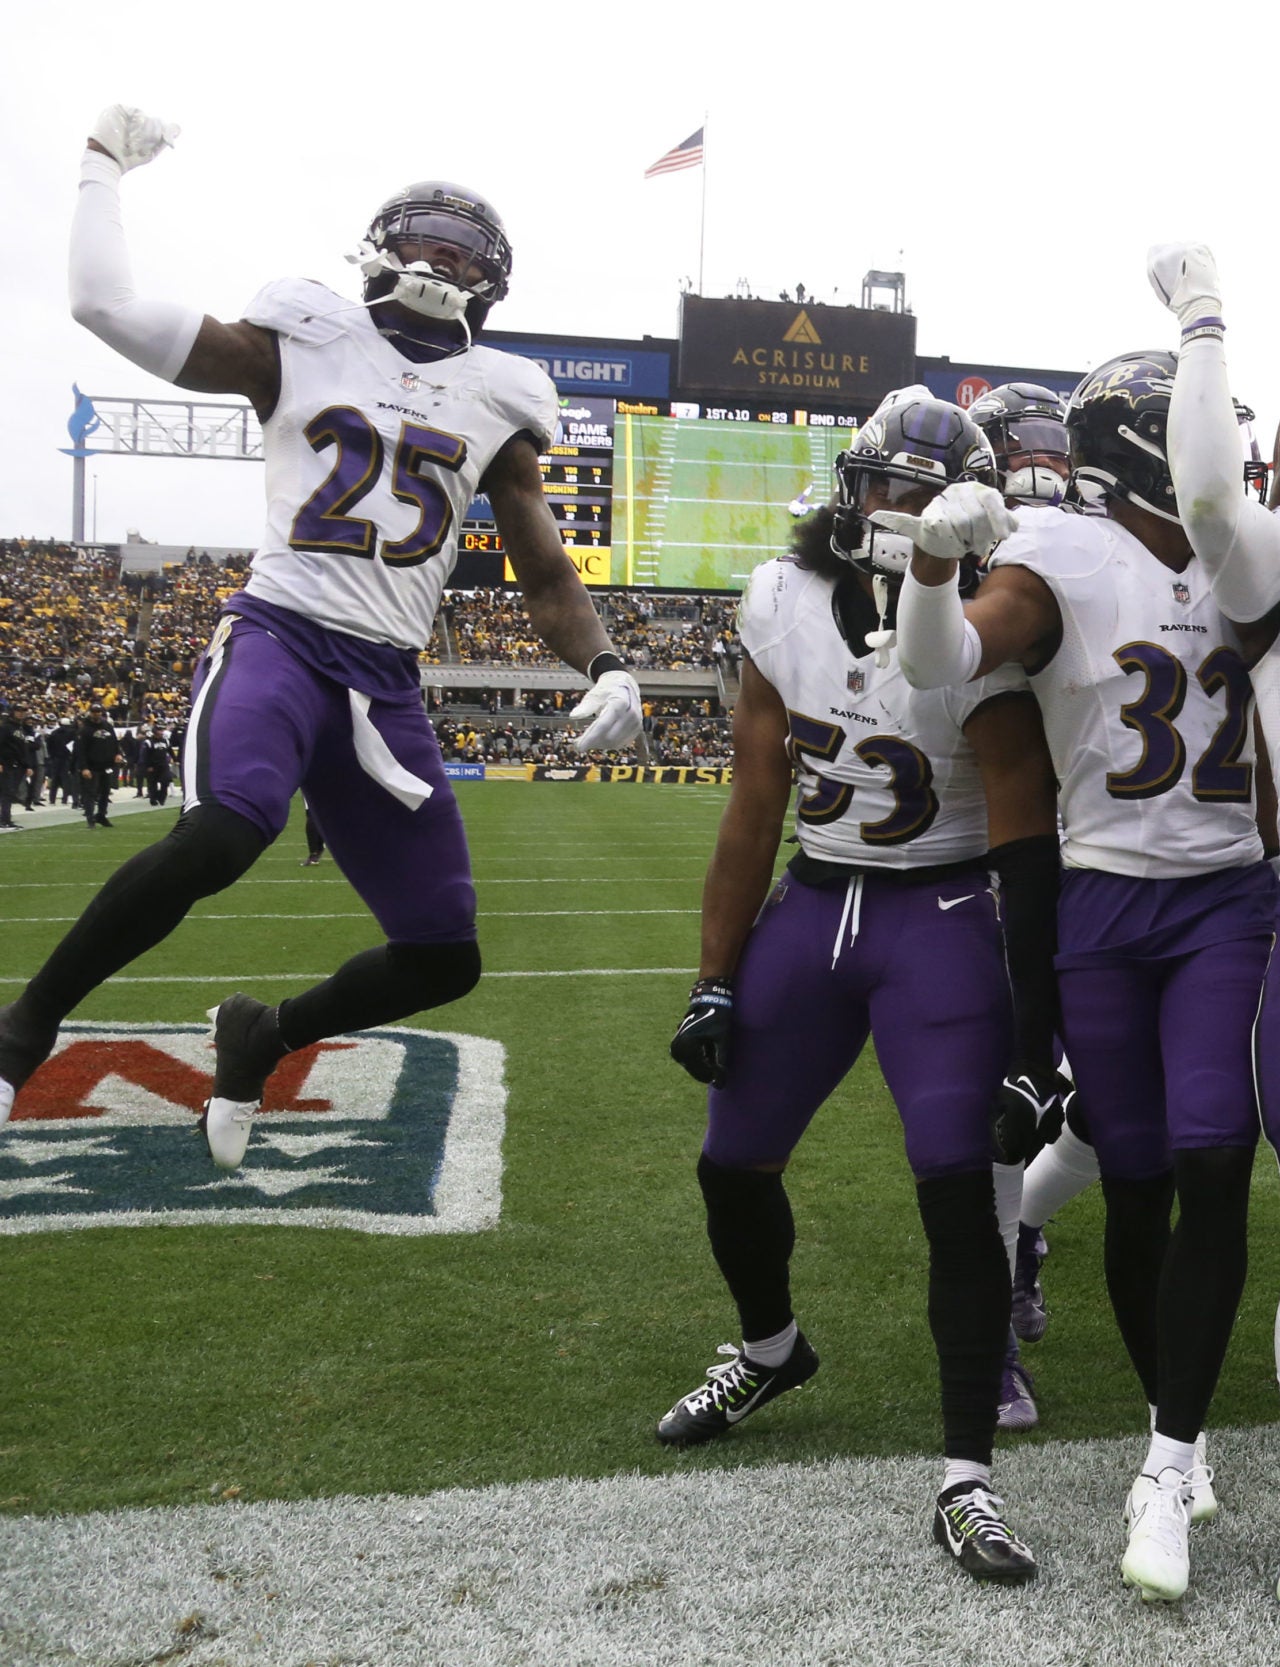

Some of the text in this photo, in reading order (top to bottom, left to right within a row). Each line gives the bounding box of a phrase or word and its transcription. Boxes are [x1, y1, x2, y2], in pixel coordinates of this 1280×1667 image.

[732, 348, 870, 373] ACRISURE
[553, 360, 627, 382] LIGHT
[759, 371, 840, 389] STADIUM
[376, 402, 428, 420] RAVENS
[617, 401, 658, 415] Steelers
[809, 414, 835, 426] 2ND
[838, 416, 858, 426] 0:21
[569, 422, 609, 436] GAME
[563, 434, 613, 446] LEADERS
[547, 446, 579, 456] ASSING
[289, 405, 467, 567] 25
[465, 534, 501, 550] 0:21
[572, 556, 602, 575] NC
[1159, 624, 1208, 633] RAVENS
[829, 706, 878, 726] RAVENS
[1107, 640, 1254, 803] 32
[464, 768, 482, 776] NFL
[788, 708, 940, 845] 53
